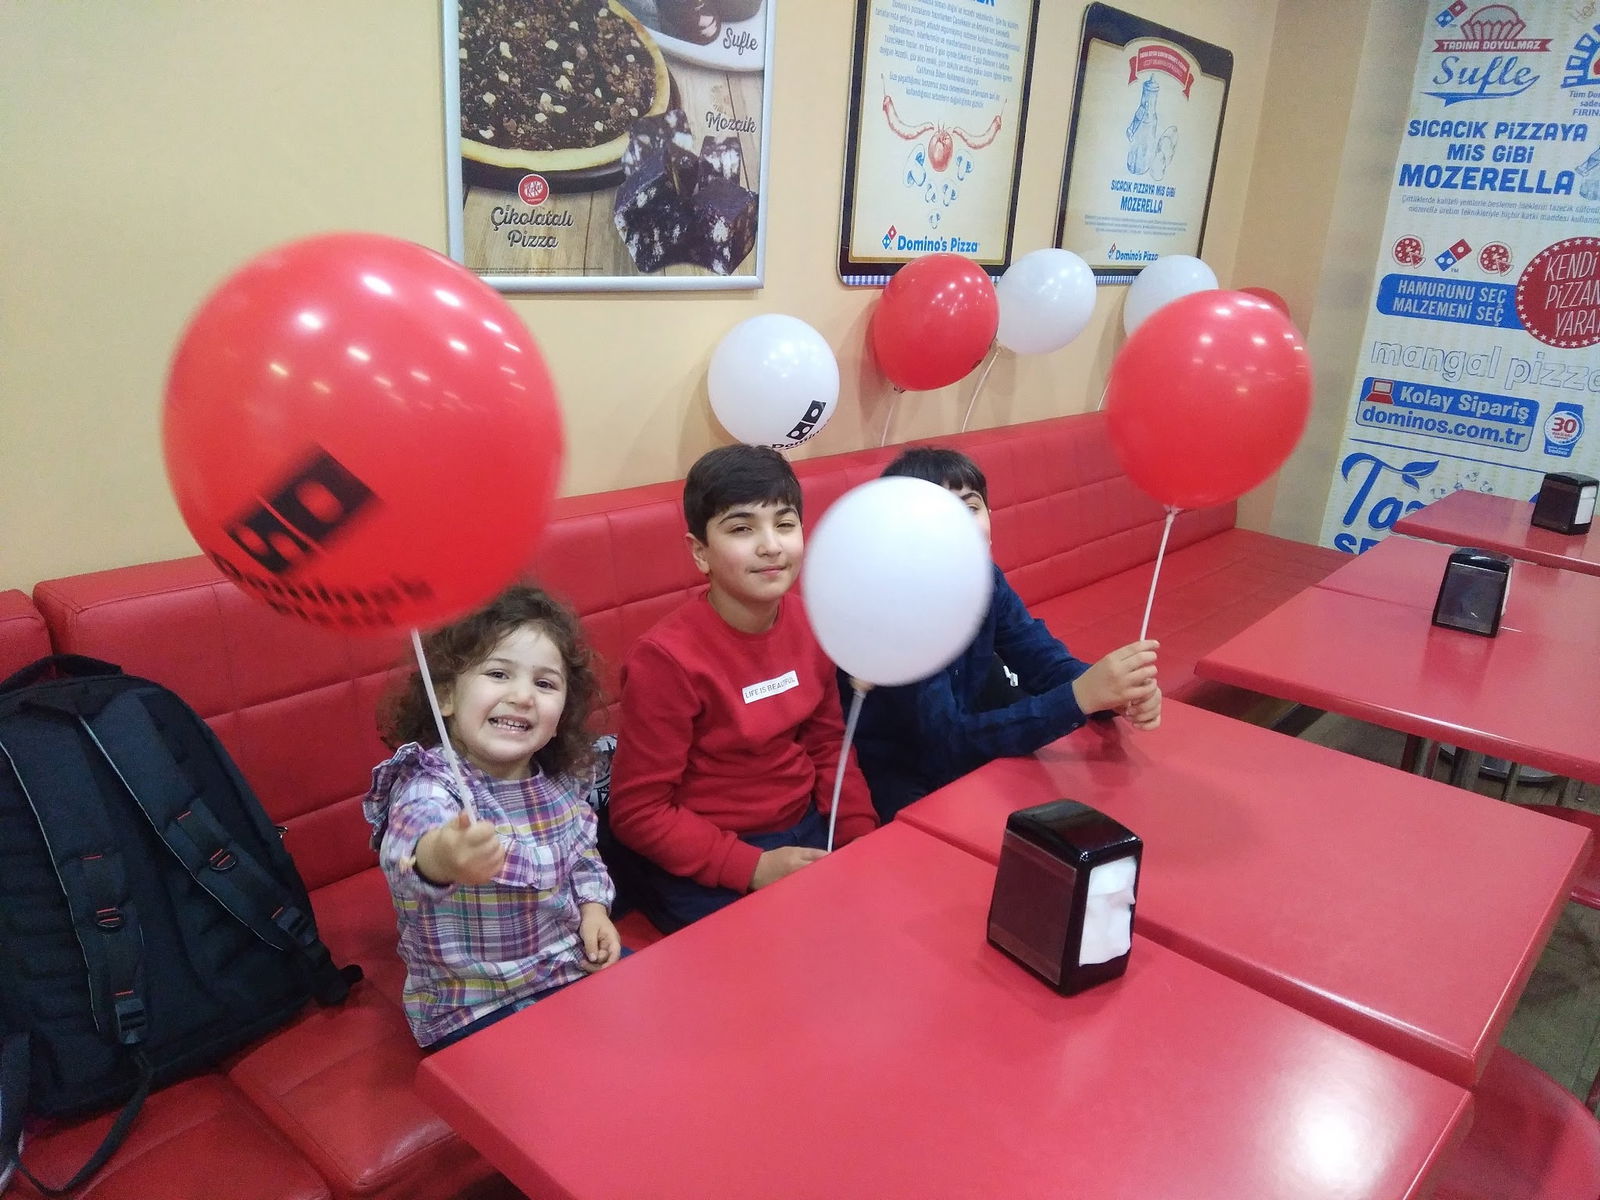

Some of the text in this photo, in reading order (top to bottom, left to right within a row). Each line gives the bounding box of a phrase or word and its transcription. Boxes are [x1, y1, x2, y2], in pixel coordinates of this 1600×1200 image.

[723, 27, 759, 55] Sufle
[1442, 40, 1542, 50] TADINA DOYULMAZ
[1432, 55, 1535, 95] Sufle
[705, 111, 757, 134] Mozaik
[1408, 119, 1489, 139] SICACIK
[1398, 163, 1576, 196] MOZERELLA
[1120, 196, 1163, 214] MOZERELLA
[490, 204, 574, 231] Çikolatalı
[507, 229, 559, 248] Pizza
[897, 235, 979, 253] Domino's Pizza
[1115, 248, 1142, 261] Domino's
[1398, 279, 1508, 309] HAMURUNU SEÇ
[1475, 305, 1505, 327] SEÇ
[1370, 341, 1503, 382] mangal
[1399, 385, 1530, 424] Kolay Sipariş
[1361, 405, 1526, 446] dominos.com.tr
[1551, 416, 1578, 434] 30
